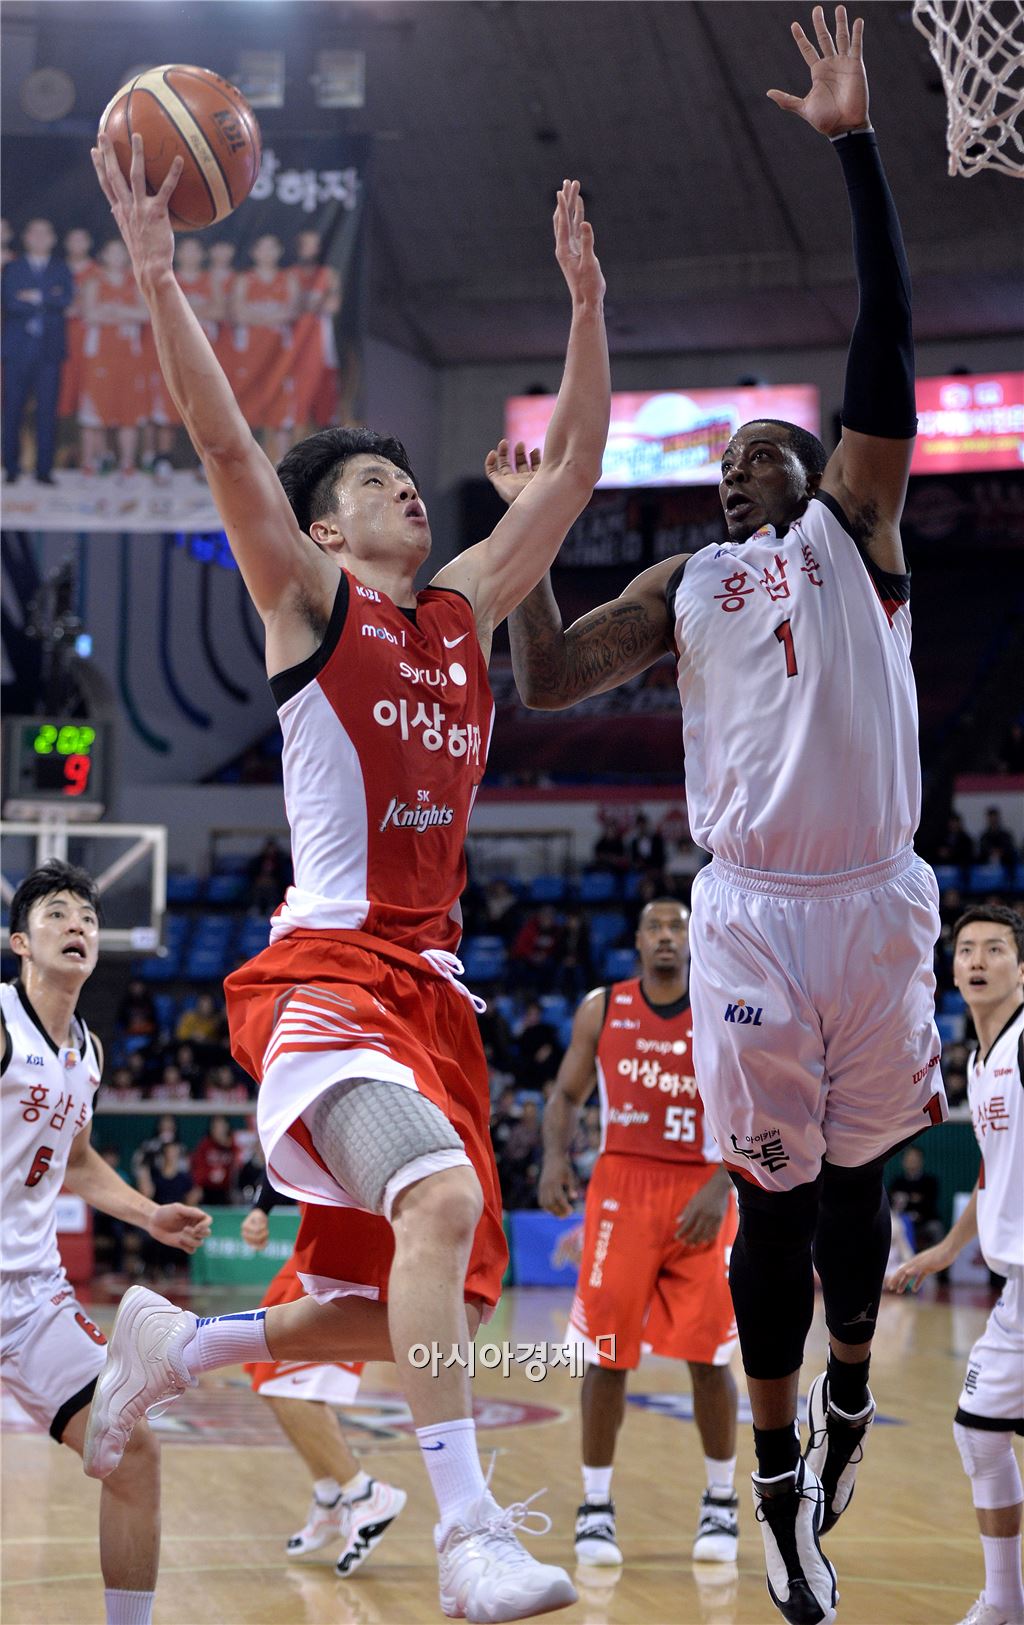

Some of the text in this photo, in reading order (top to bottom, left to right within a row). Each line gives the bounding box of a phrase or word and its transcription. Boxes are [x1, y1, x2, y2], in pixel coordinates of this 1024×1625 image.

[213, 109, 246, 154] KBL
[356, 586, 382, 603] KBL
[773, 618, 798, 678] 1
[373, 699, 482, 766] 이상하자
[63, 753, 91, 796] 9
[417, 789, 430, 802] SK
[379, 796, 454, 833] Knights
[724, 1002, 763, 1026] KBL
[617, 1057, 698, 1100] 이상하자
[663, 1106, 697, 1143] 55
[922, 1092, 944, 1127] 1
[24, 1145, 54, 1188] 6
[74, 1312, 108, 1346] 6
